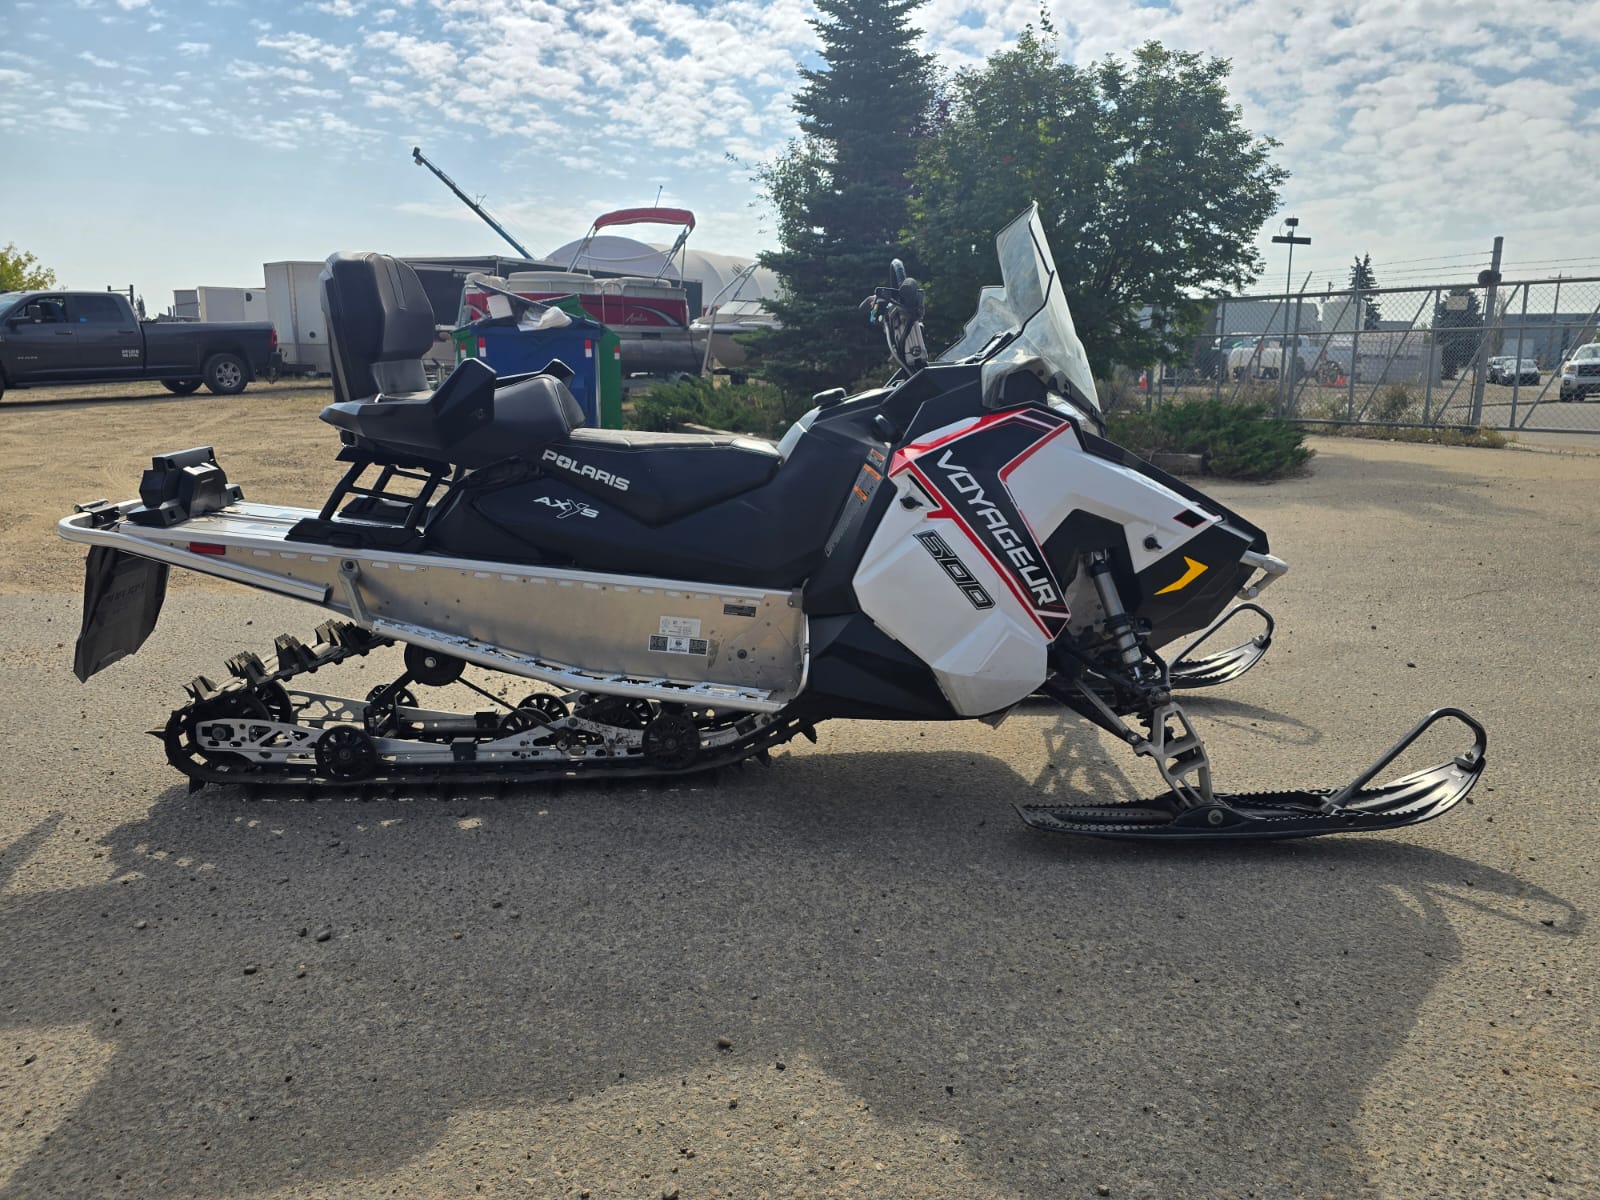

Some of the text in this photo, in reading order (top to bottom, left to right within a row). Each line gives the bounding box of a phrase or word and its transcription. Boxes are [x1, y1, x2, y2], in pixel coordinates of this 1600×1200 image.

[542, 449, 630, 491] POLARIS
[533, 497, 599, 518] AXYS
[937, 449, 1057, 606] VOYAGEUR
